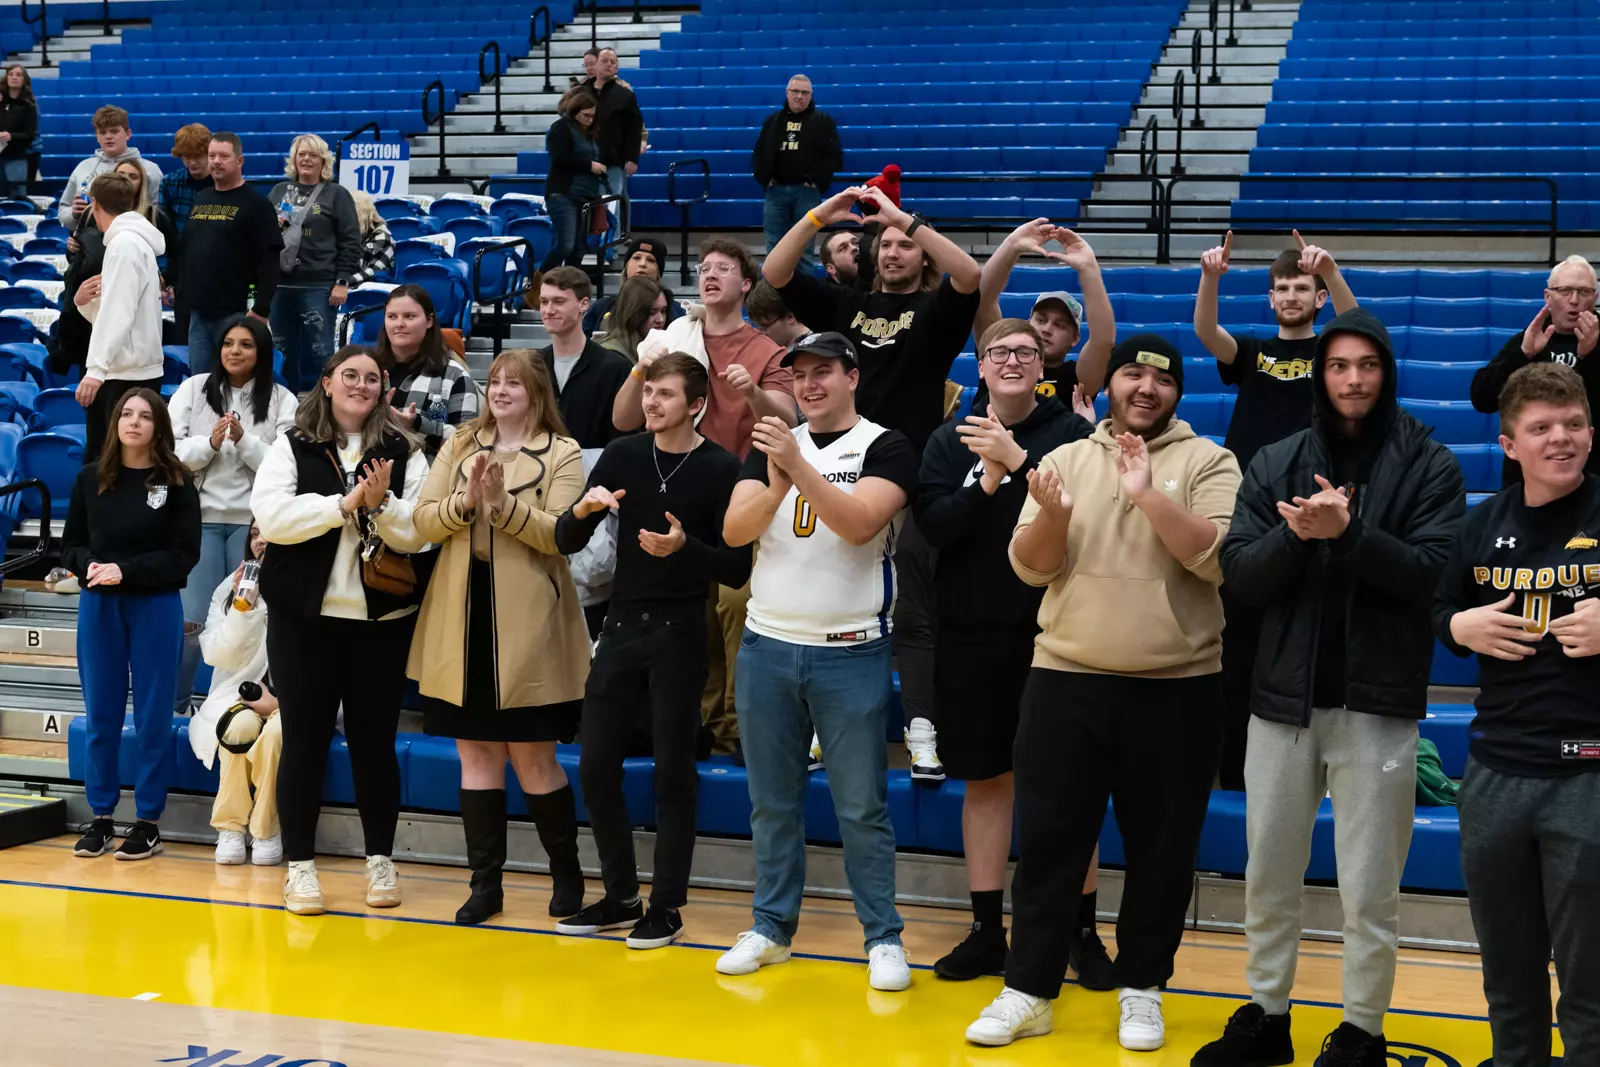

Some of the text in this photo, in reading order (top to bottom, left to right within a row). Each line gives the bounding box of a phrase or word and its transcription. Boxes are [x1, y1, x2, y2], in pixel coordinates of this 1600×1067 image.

[350, 143, 400, 159] SECTION
[354, 165, 395, 194] 107
[191, 204, 239, 216] PURDUE
[850, 311, 915, 338] PURDUE
[1473, 564, 1600, 590] PURDUE
[28, 631, 40, 647] B
[44, 715, 59, 733] A
